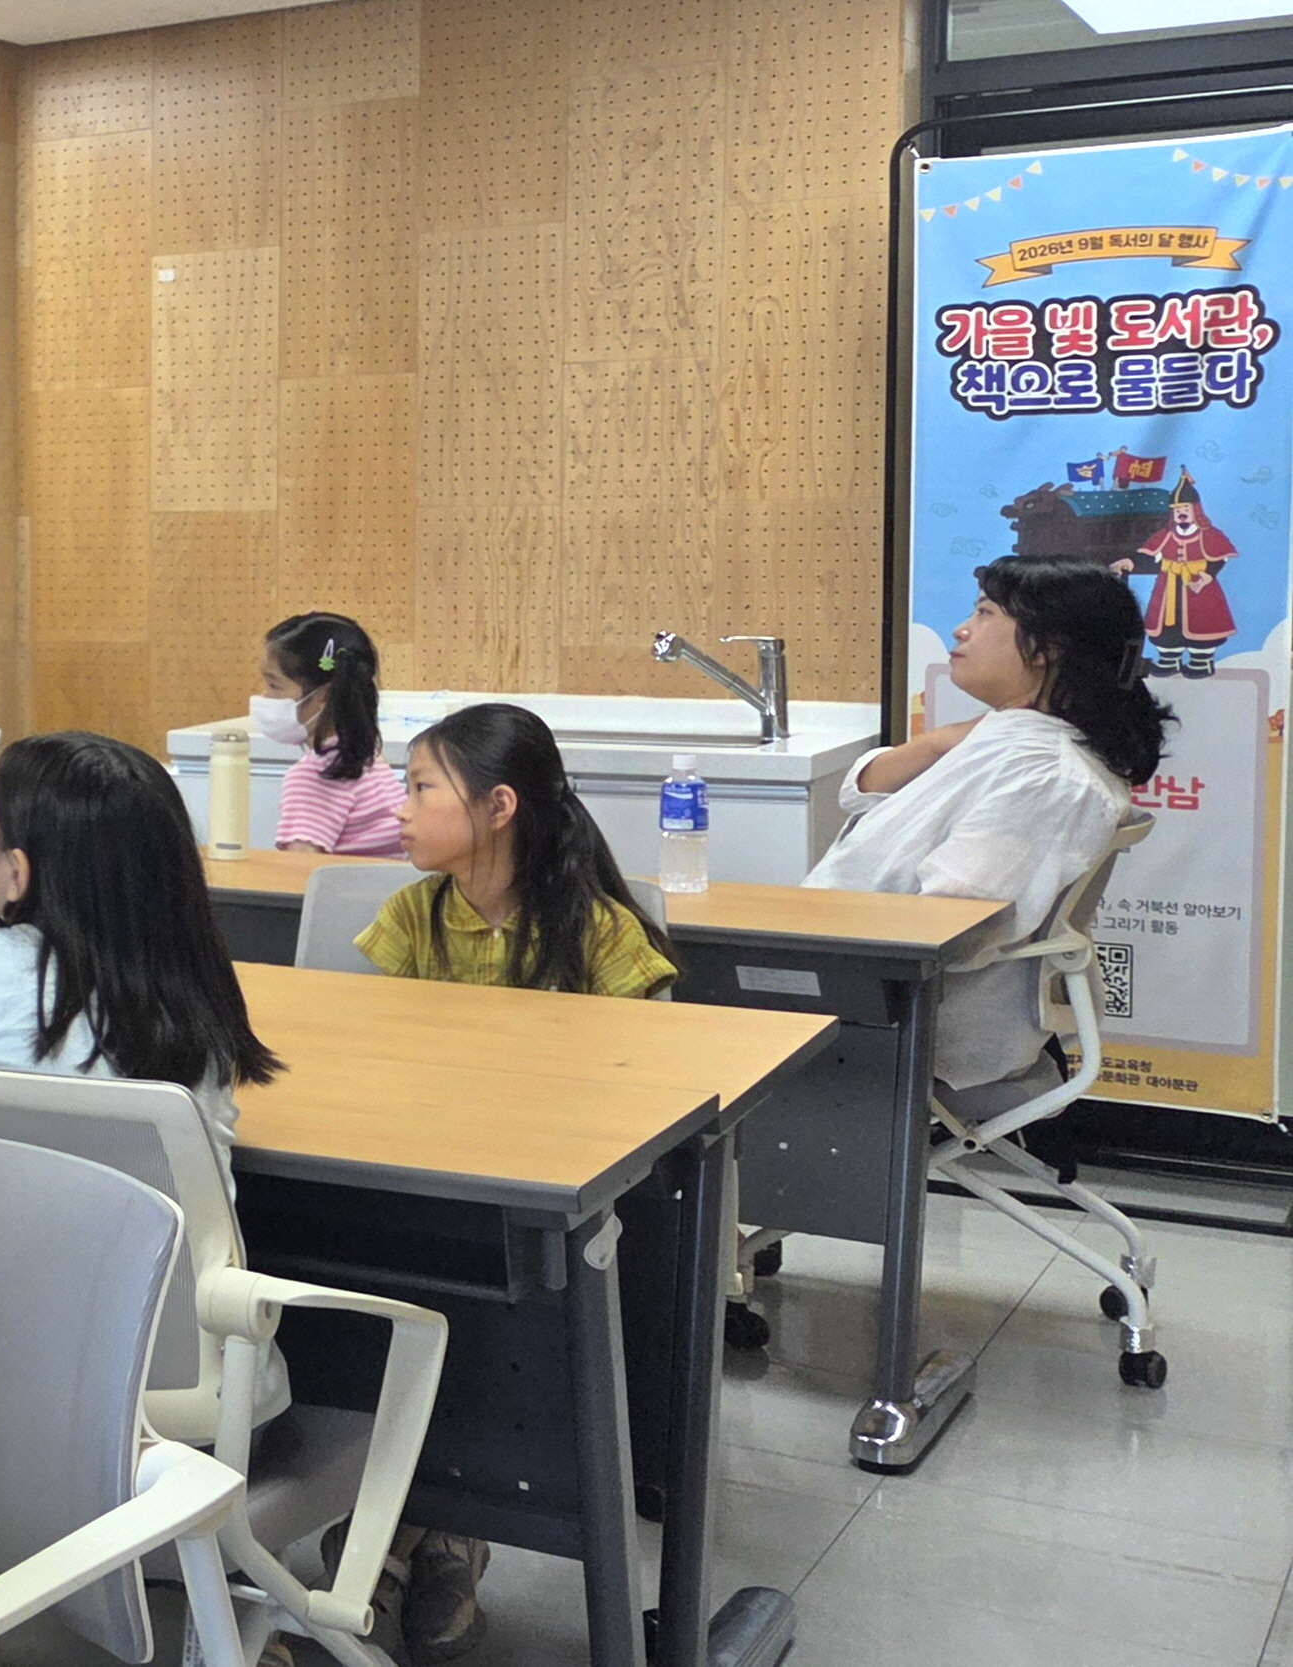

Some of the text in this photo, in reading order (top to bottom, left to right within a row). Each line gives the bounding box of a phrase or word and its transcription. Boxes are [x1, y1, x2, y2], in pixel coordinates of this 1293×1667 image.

[1017, 232, 1209, 262] 2026년 9월 독서의 달 행사
[944, 291, 1275, 359] 가을 빛 도서관,
[957, 351, 1256, 415] 책으로 물들다
[1130, 775, 1206, 810] 만남
[1117, 898, 1132, 912] 속
[1135, 900, 1179, 915] 거북선
[1183, 903, 1242, 920] 알아보기
[1103, 917, 1145, 932] 그리기
[1150, 920, 1179, 935] 활동
